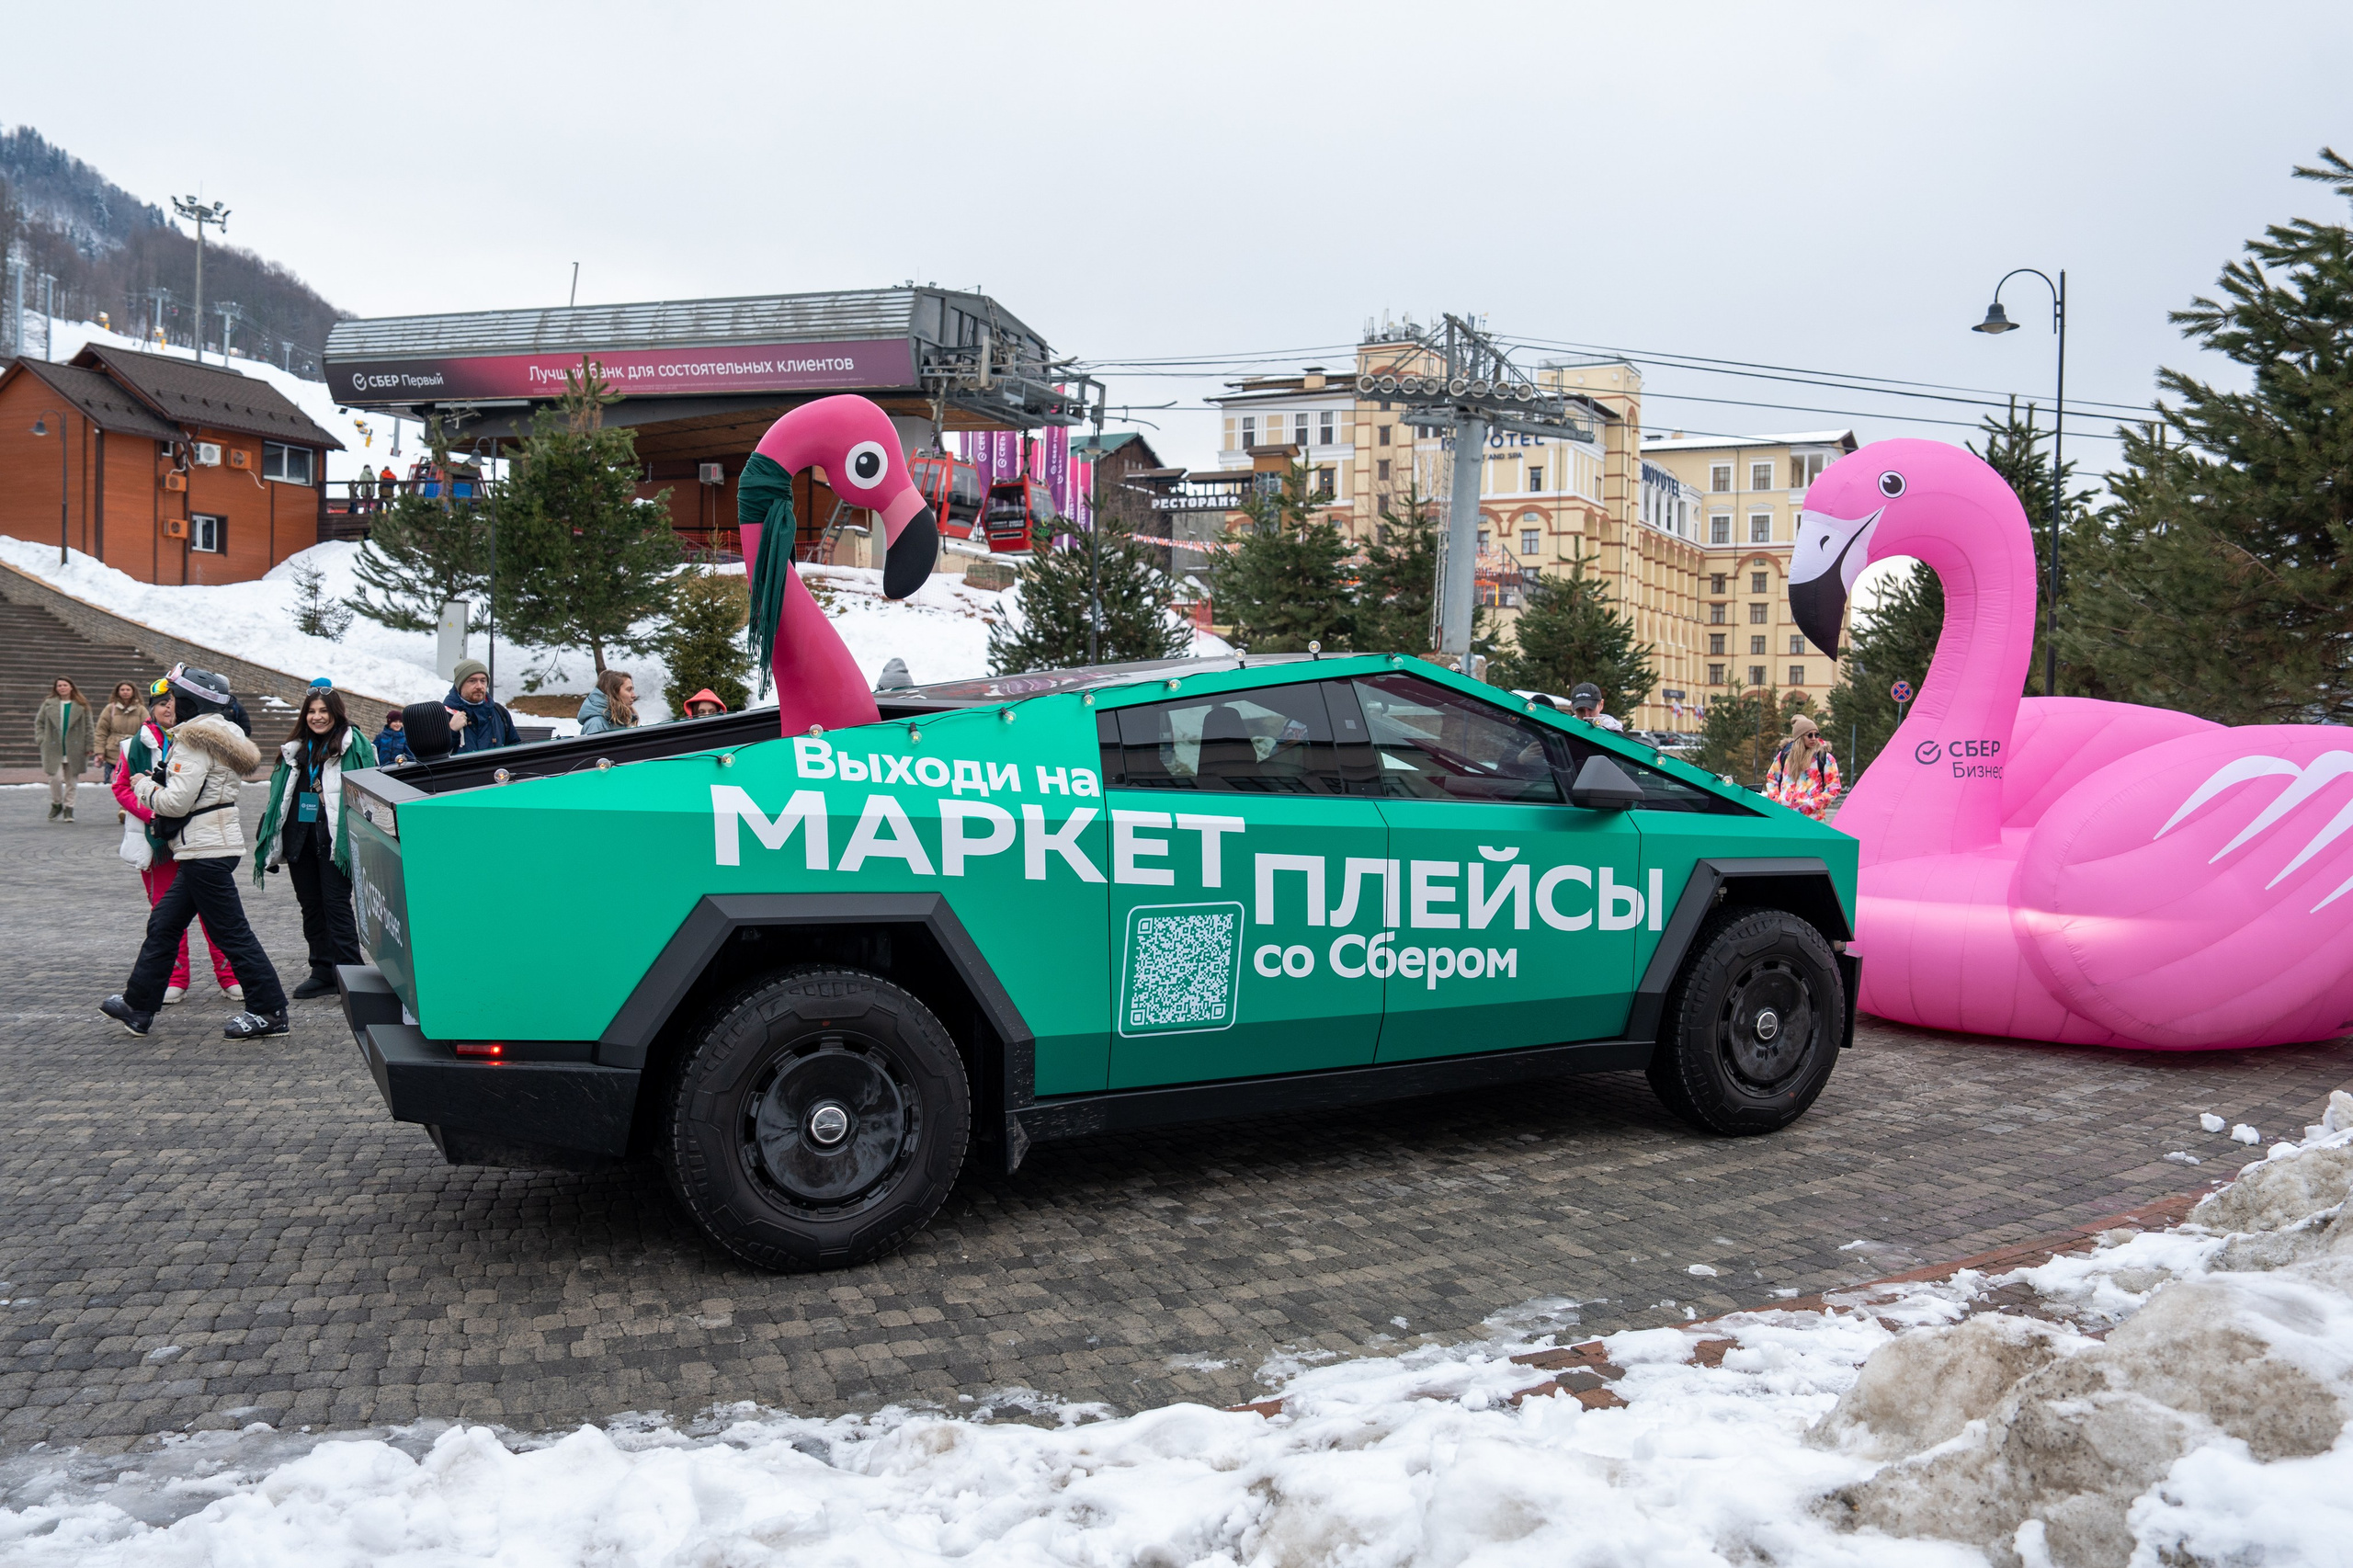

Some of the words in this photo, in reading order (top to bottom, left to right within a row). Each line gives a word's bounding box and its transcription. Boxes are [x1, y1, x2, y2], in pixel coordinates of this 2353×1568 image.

[369, 375, 399, 387] СБЕР
[401, 372, 444, 388] Первый
[588, 362, 625, 379] банк
[628, 366, 654, 381] для
[658, 361, 774, 377] состоятельных
[777, 358, 855, 372] клиентов
[1642, 462, 1680, 498] NOVOTEL
[793, 736, 1022, 798] Выходи
[1036, 765, 1100, 798] на
[1949, 740, 2001, 757] СБЕР
[1952, 761, 2003, 779] Бизнес
[710, 784, 1245, 889] МАРКЕТ
[369, 881, 383, 924] СБЕР
[1254, 845, 1664, 932] ПЛЕЙСЫ
[1253, 943, 1315, 978] со
[1329, 931, 1518, 990] Сбером
